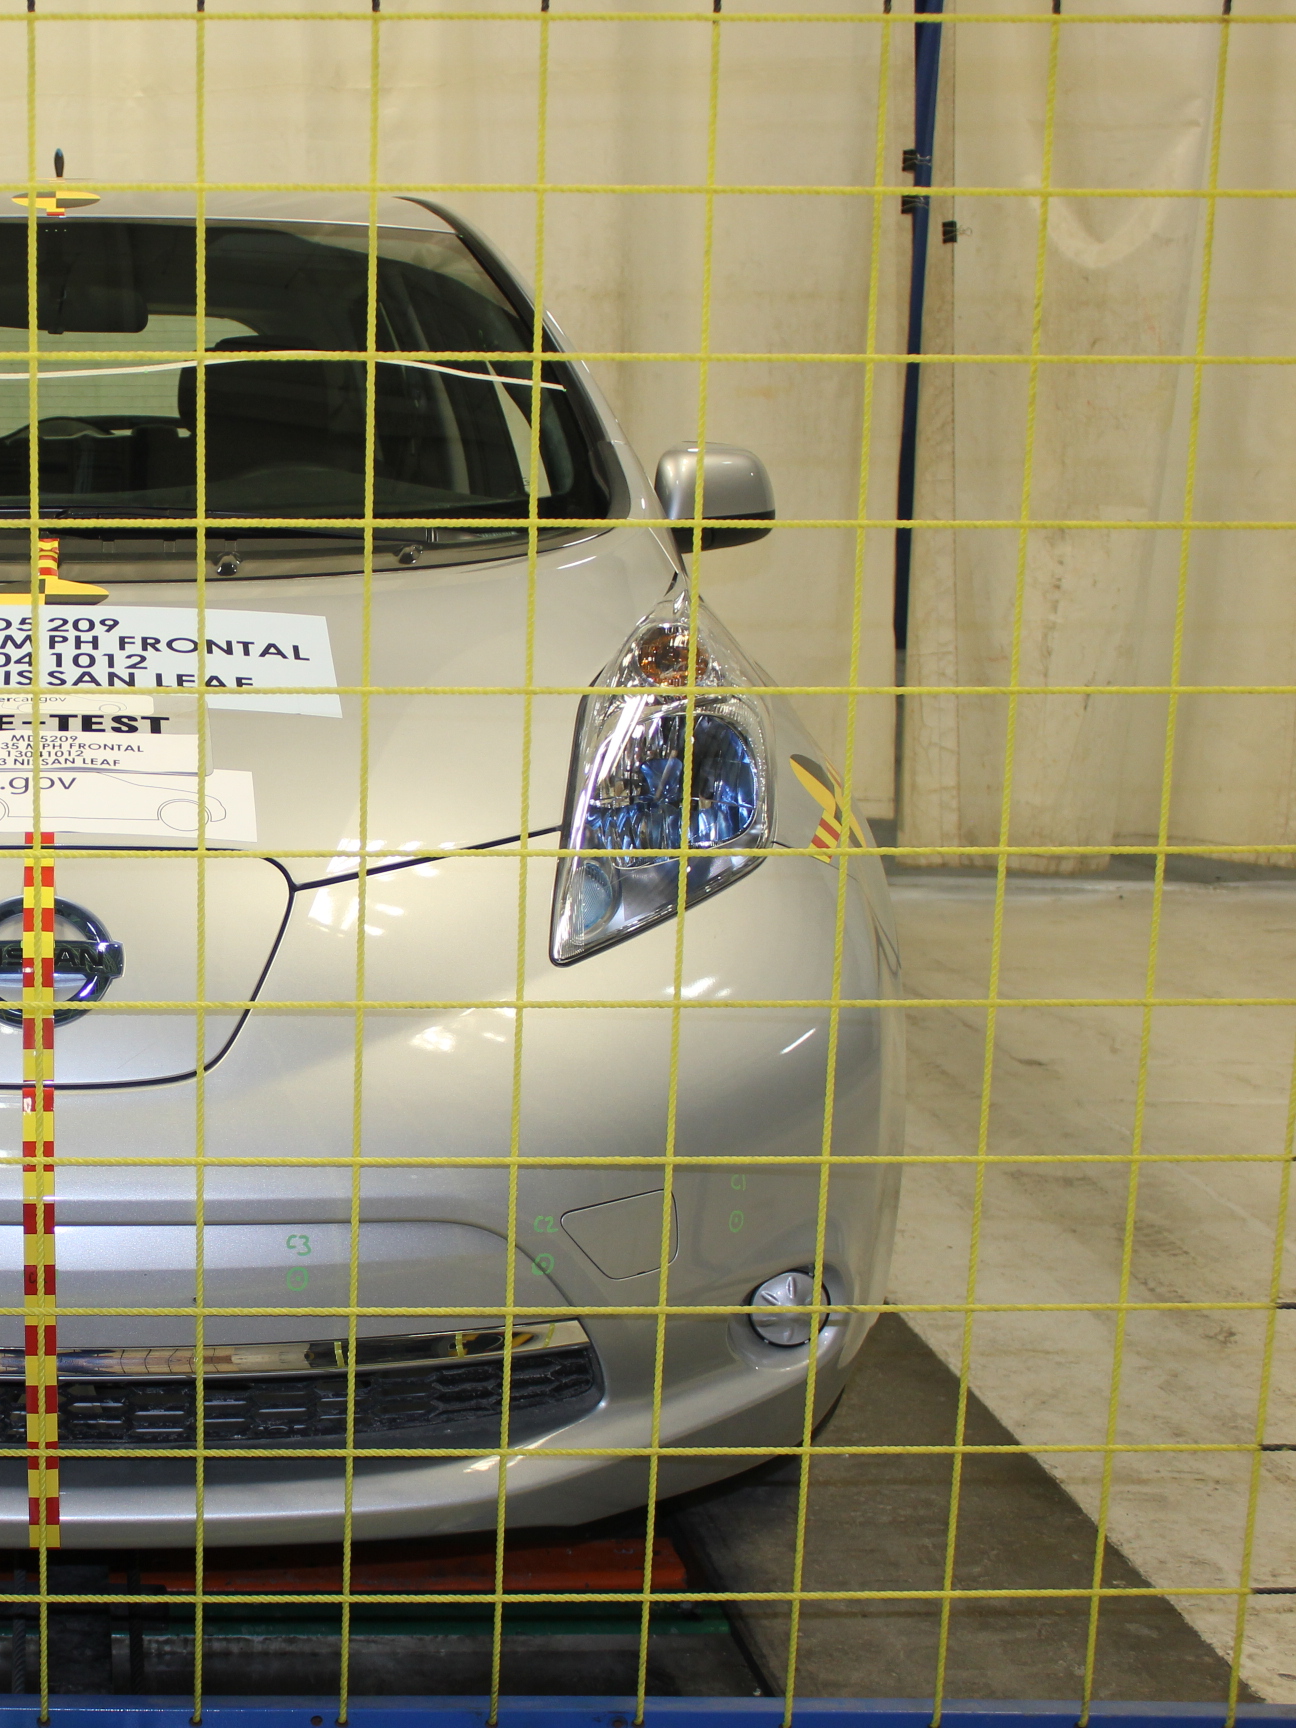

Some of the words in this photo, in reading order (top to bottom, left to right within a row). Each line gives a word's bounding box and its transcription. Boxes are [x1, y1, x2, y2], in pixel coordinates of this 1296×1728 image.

[0, 634, 100, 651] MPH
[118, 635, 311, 662] FRONTAL
[154, 672, 254, 688] LEAF
[0, 742, 20, 750] 35
[69, 742, 144, 752] FRONTAL
[13, 757, 76, 766] NISAN
[82, 757, 121, 767] LEAF
[533, 1215, 559, 1233] C2
[285, 1234, 312, 1257] C3
